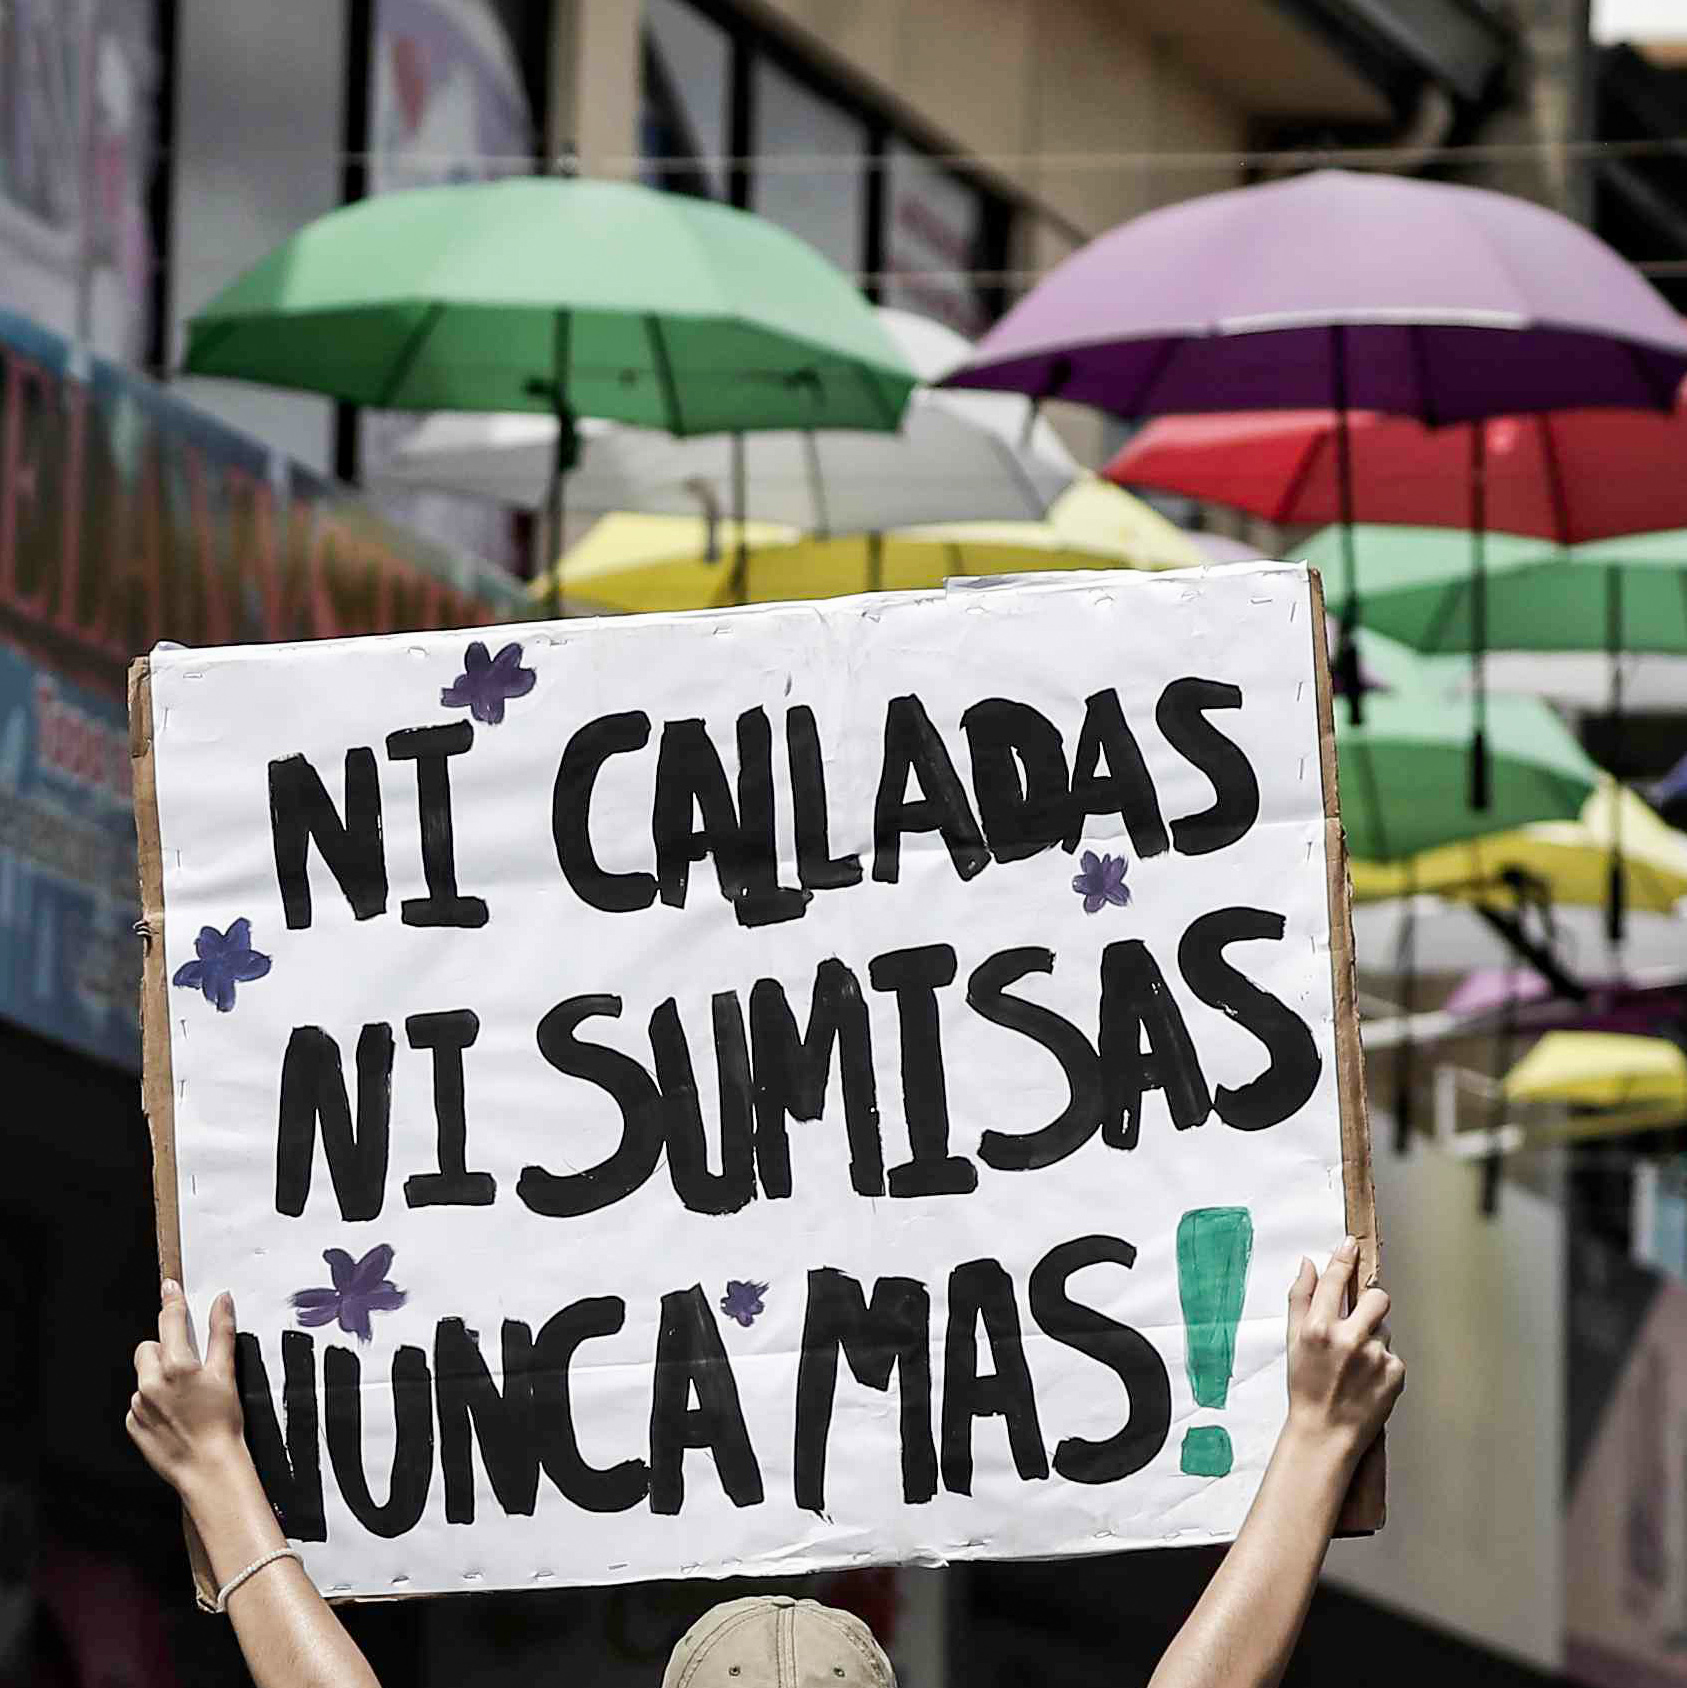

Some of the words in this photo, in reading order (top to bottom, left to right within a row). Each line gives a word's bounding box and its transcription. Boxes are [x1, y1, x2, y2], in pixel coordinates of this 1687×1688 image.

[268, 719, 490, 930] NI
[552, 677, 1260, 928] CALLADAS
[275, 1009, 497, 1223] NI
[516, 907, 1323, 1218] SUMISAS
[233, 1283, 765, 1543] NUNCA
[793, 1206, 1254, 1523] MAS!
